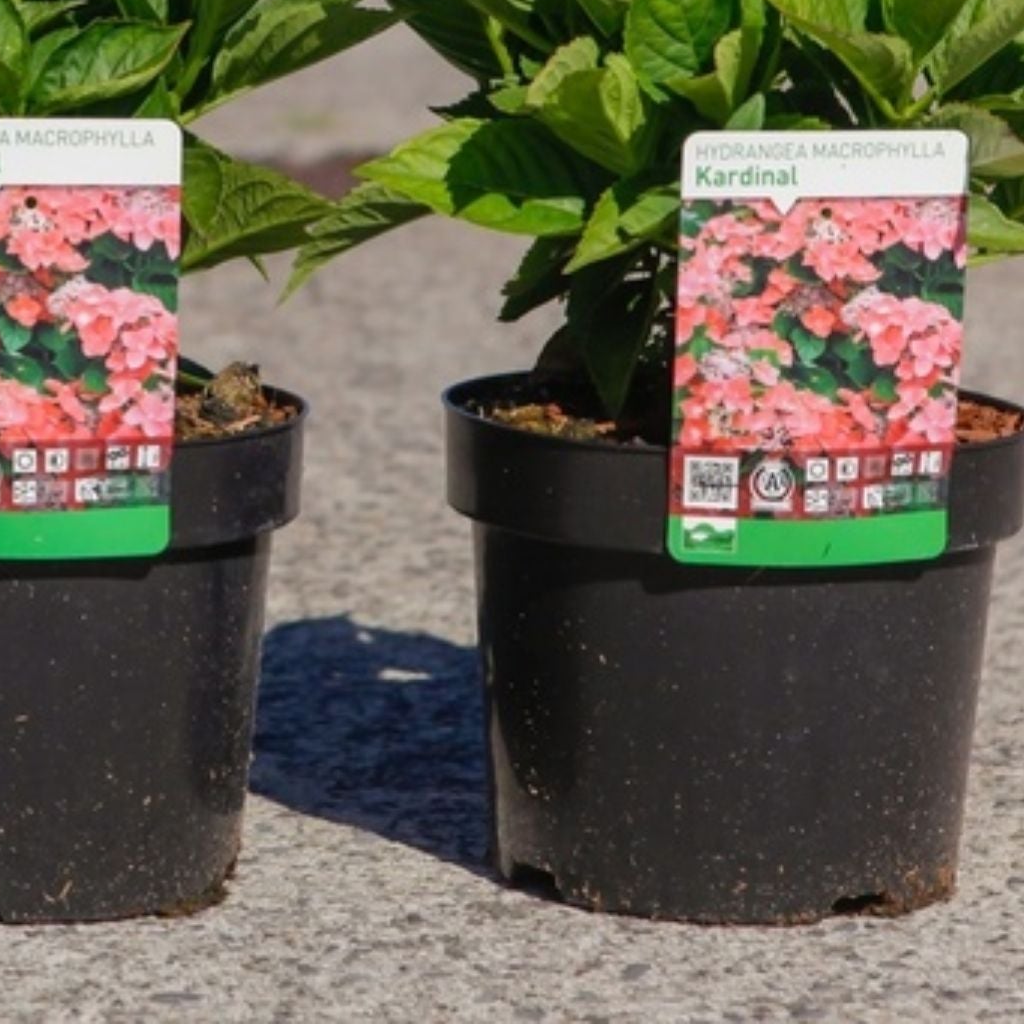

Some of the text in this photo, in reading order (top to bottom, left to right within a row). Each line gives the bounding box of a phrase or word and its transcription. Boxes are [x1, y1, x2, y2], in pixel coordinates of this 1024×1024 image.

[15, 129, 155, 147] MACROPHYLLA
[695, 141, 946, 160] HYDRANGEA MACROPHYLLA
[695, 165, 799, 187] Kardinal
